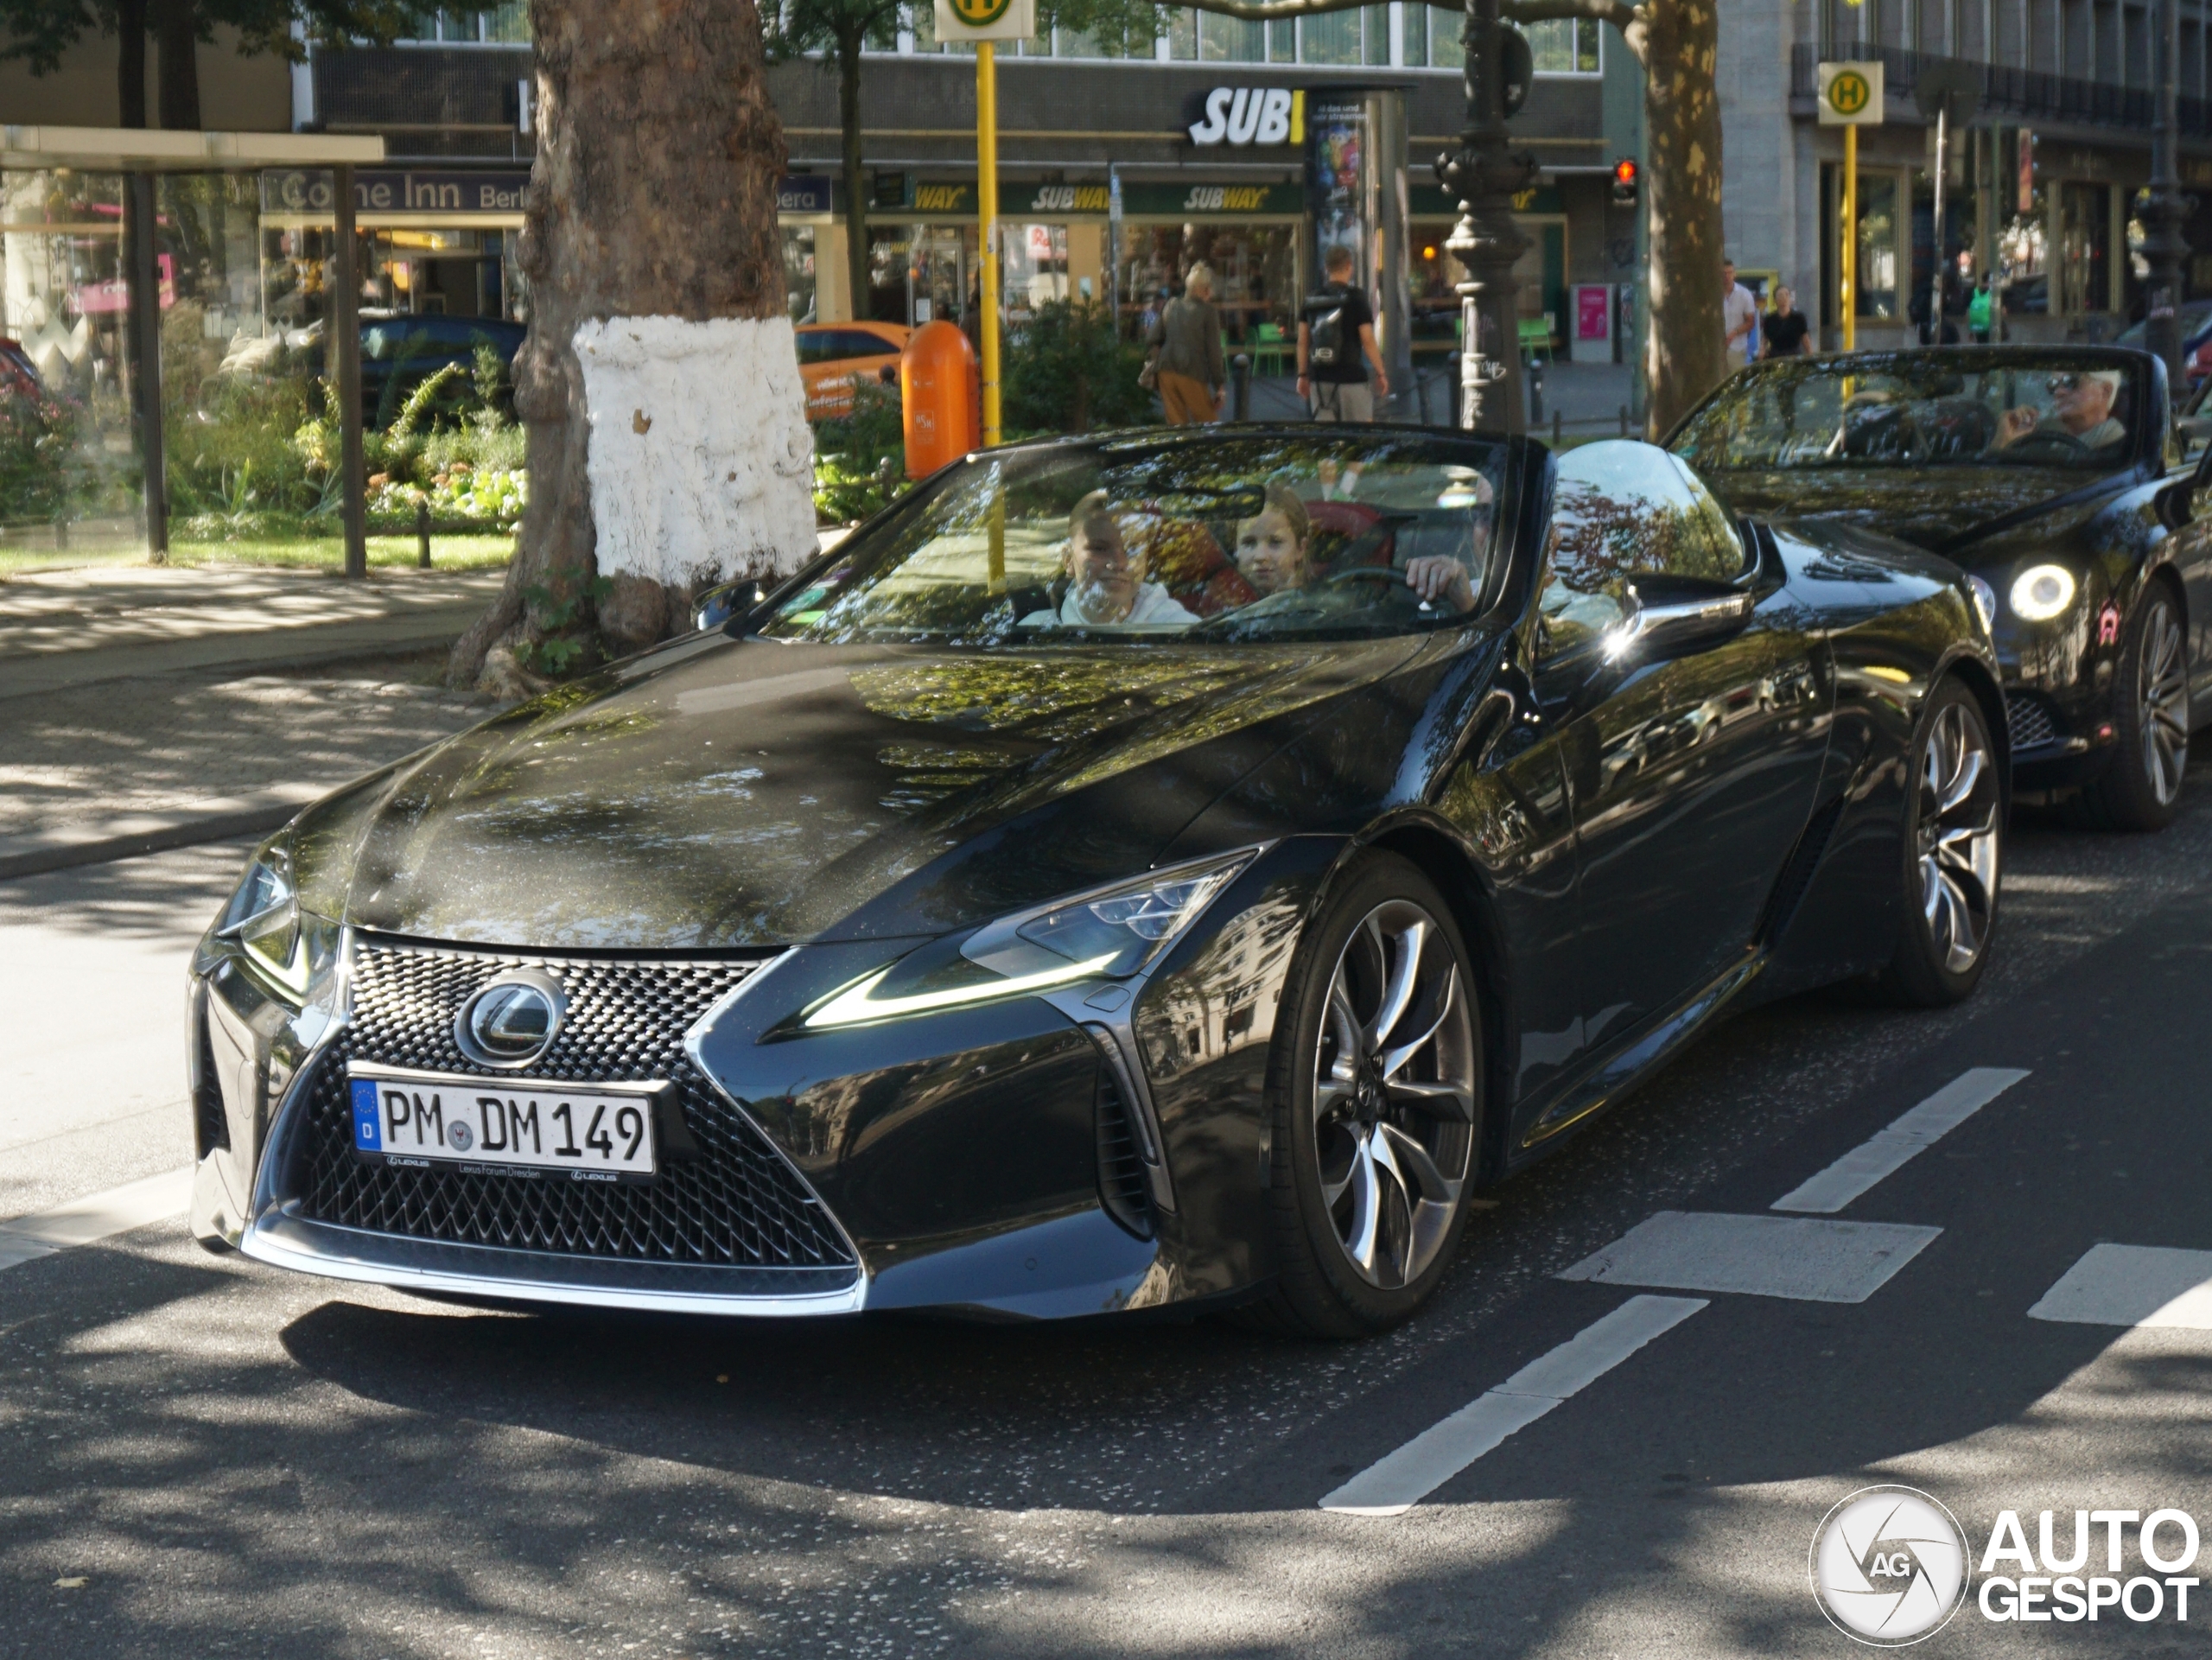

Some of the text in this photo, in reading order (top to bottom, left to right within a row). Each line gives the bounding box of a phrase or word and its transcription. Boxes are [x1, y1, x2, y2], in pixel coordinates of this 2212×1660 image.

[1838, 80, 1858, 105] H
[404, 175, 460, 207] Inn
[480, 185, 524, 207] Berl
[914, 185, 967, 210] WAY
[1031, 186, 1110, 210] SUBWA
[1184, 186, 1270, 210] SUBWAY
[363, 1090, 644, 1161] D PM DM 149
[397, 1158, 430, 1167] LEXUS
[459, 1162, 541, 1179] Lexus Forum Dresden
[582, 1173, 617, 1182] LEXUS
